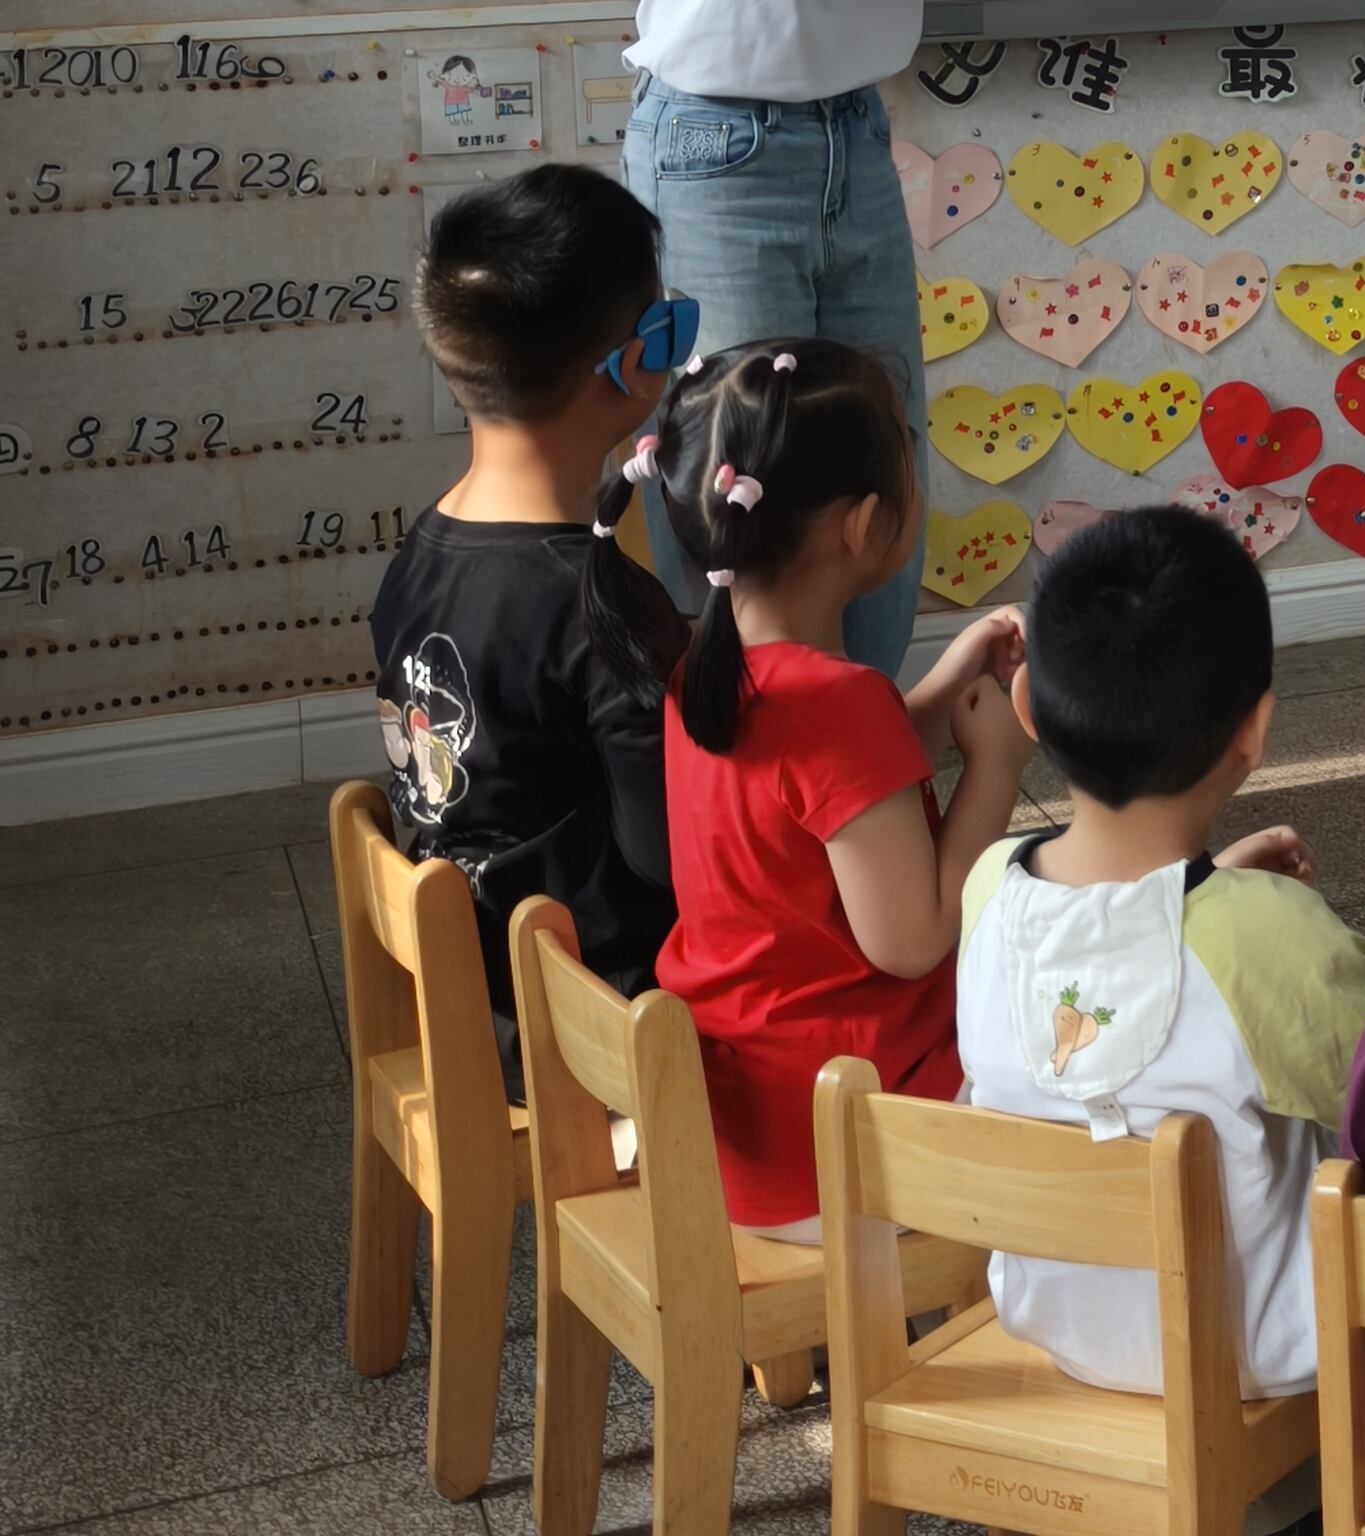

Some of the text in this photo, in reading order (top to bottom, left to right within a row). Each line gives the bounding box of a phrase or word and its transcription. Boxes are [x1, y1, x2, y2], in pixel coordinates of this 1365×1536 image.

[32, 164, 63, 203] 5
[79, 293, 127, 332] 15
[66, 392, 367, 457] 8 13 2 24
[66, 539, 105, 579] 18
[297, 510, 344, 548] 19
[970, 1475, 1050, 1506] FEIYOU
